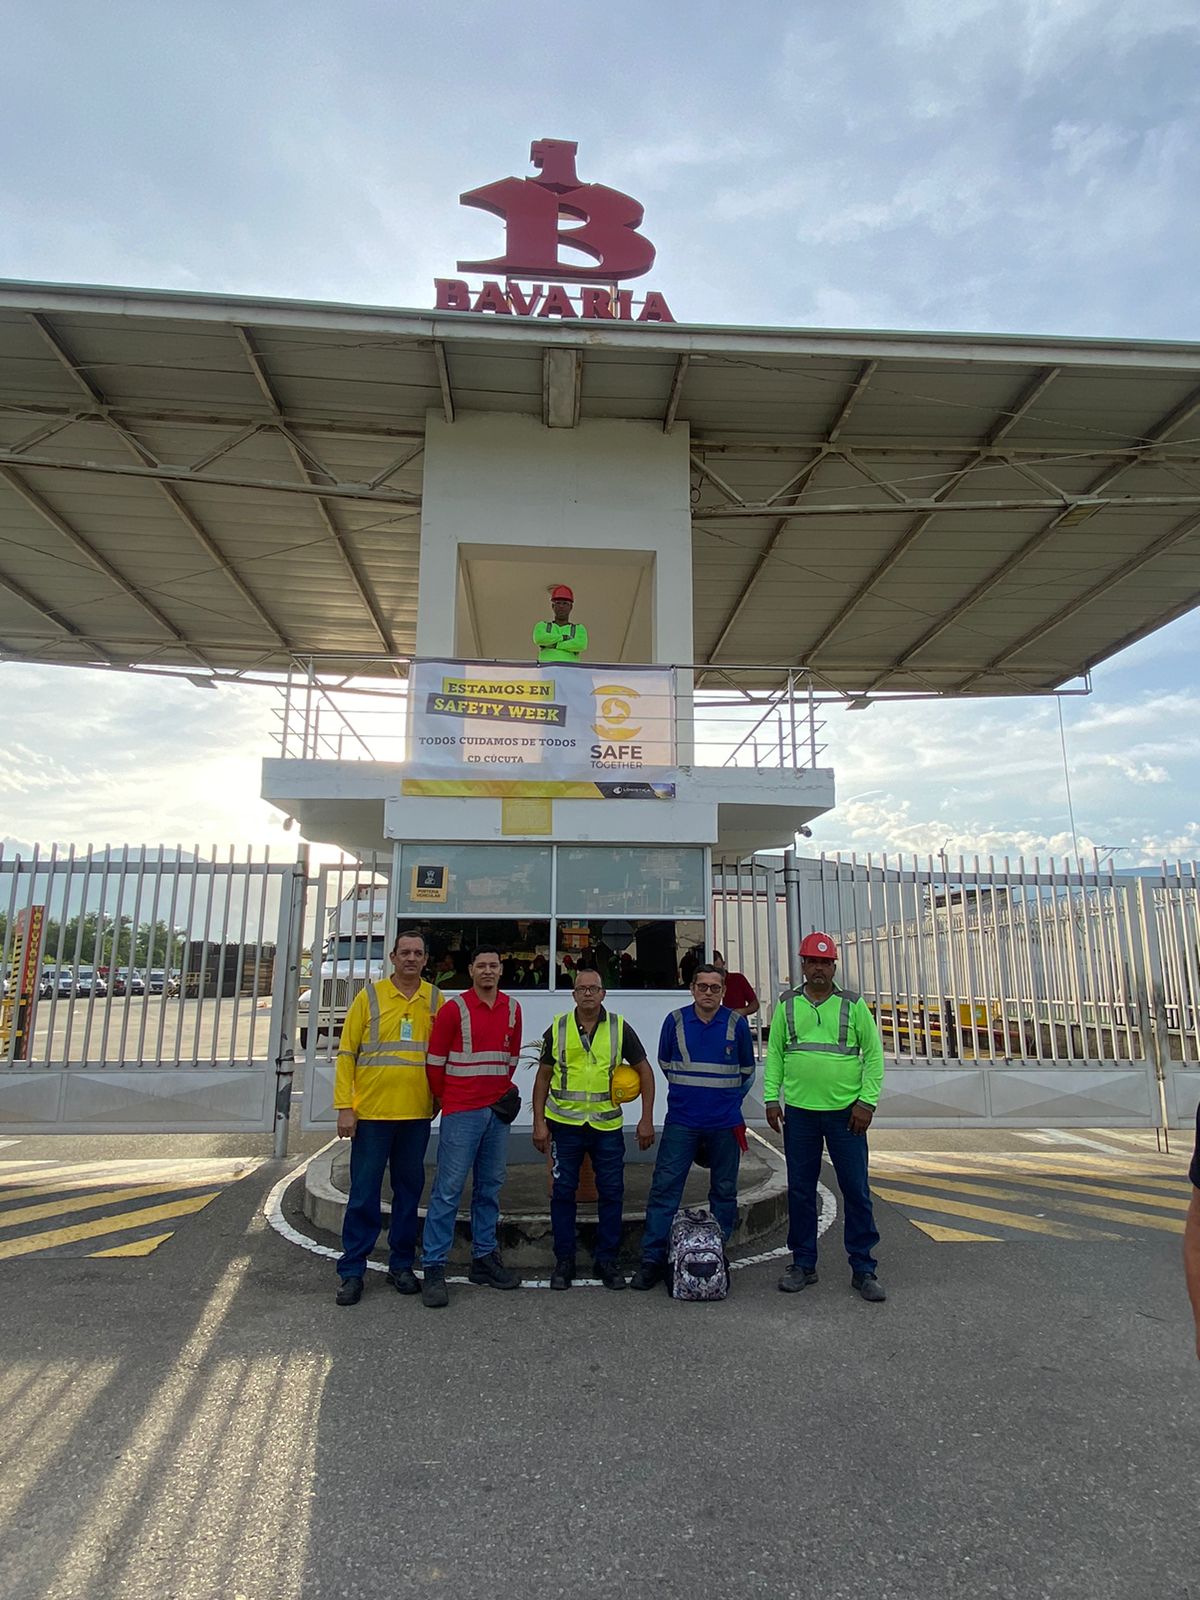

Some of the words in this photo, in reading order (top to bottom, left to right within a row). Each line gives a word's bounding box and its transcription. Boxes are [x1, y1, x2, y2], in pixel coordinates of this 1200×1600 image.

[433, 277, 677, 323] BAVARIA
[447, 682, 525, 696] ESTAMOS
[529, 685, 550, 696] EN
[433, 698, 505, 717] SAFETY
[508, 705, 560, 722] WEEK
[418, 736, 456, 746] TODOS
[458, 736, 519, 747] CUIDAMOS
[520, 738, 536, 747] DE
[538, 738, 577, 748] TODOS
[467, 754, 482, 763] CD
[483, 753, 524, 764] CÚCUTA
[589, 744, 643, 760] SAFE
[590, 760, 643, 769] TOGETHER
